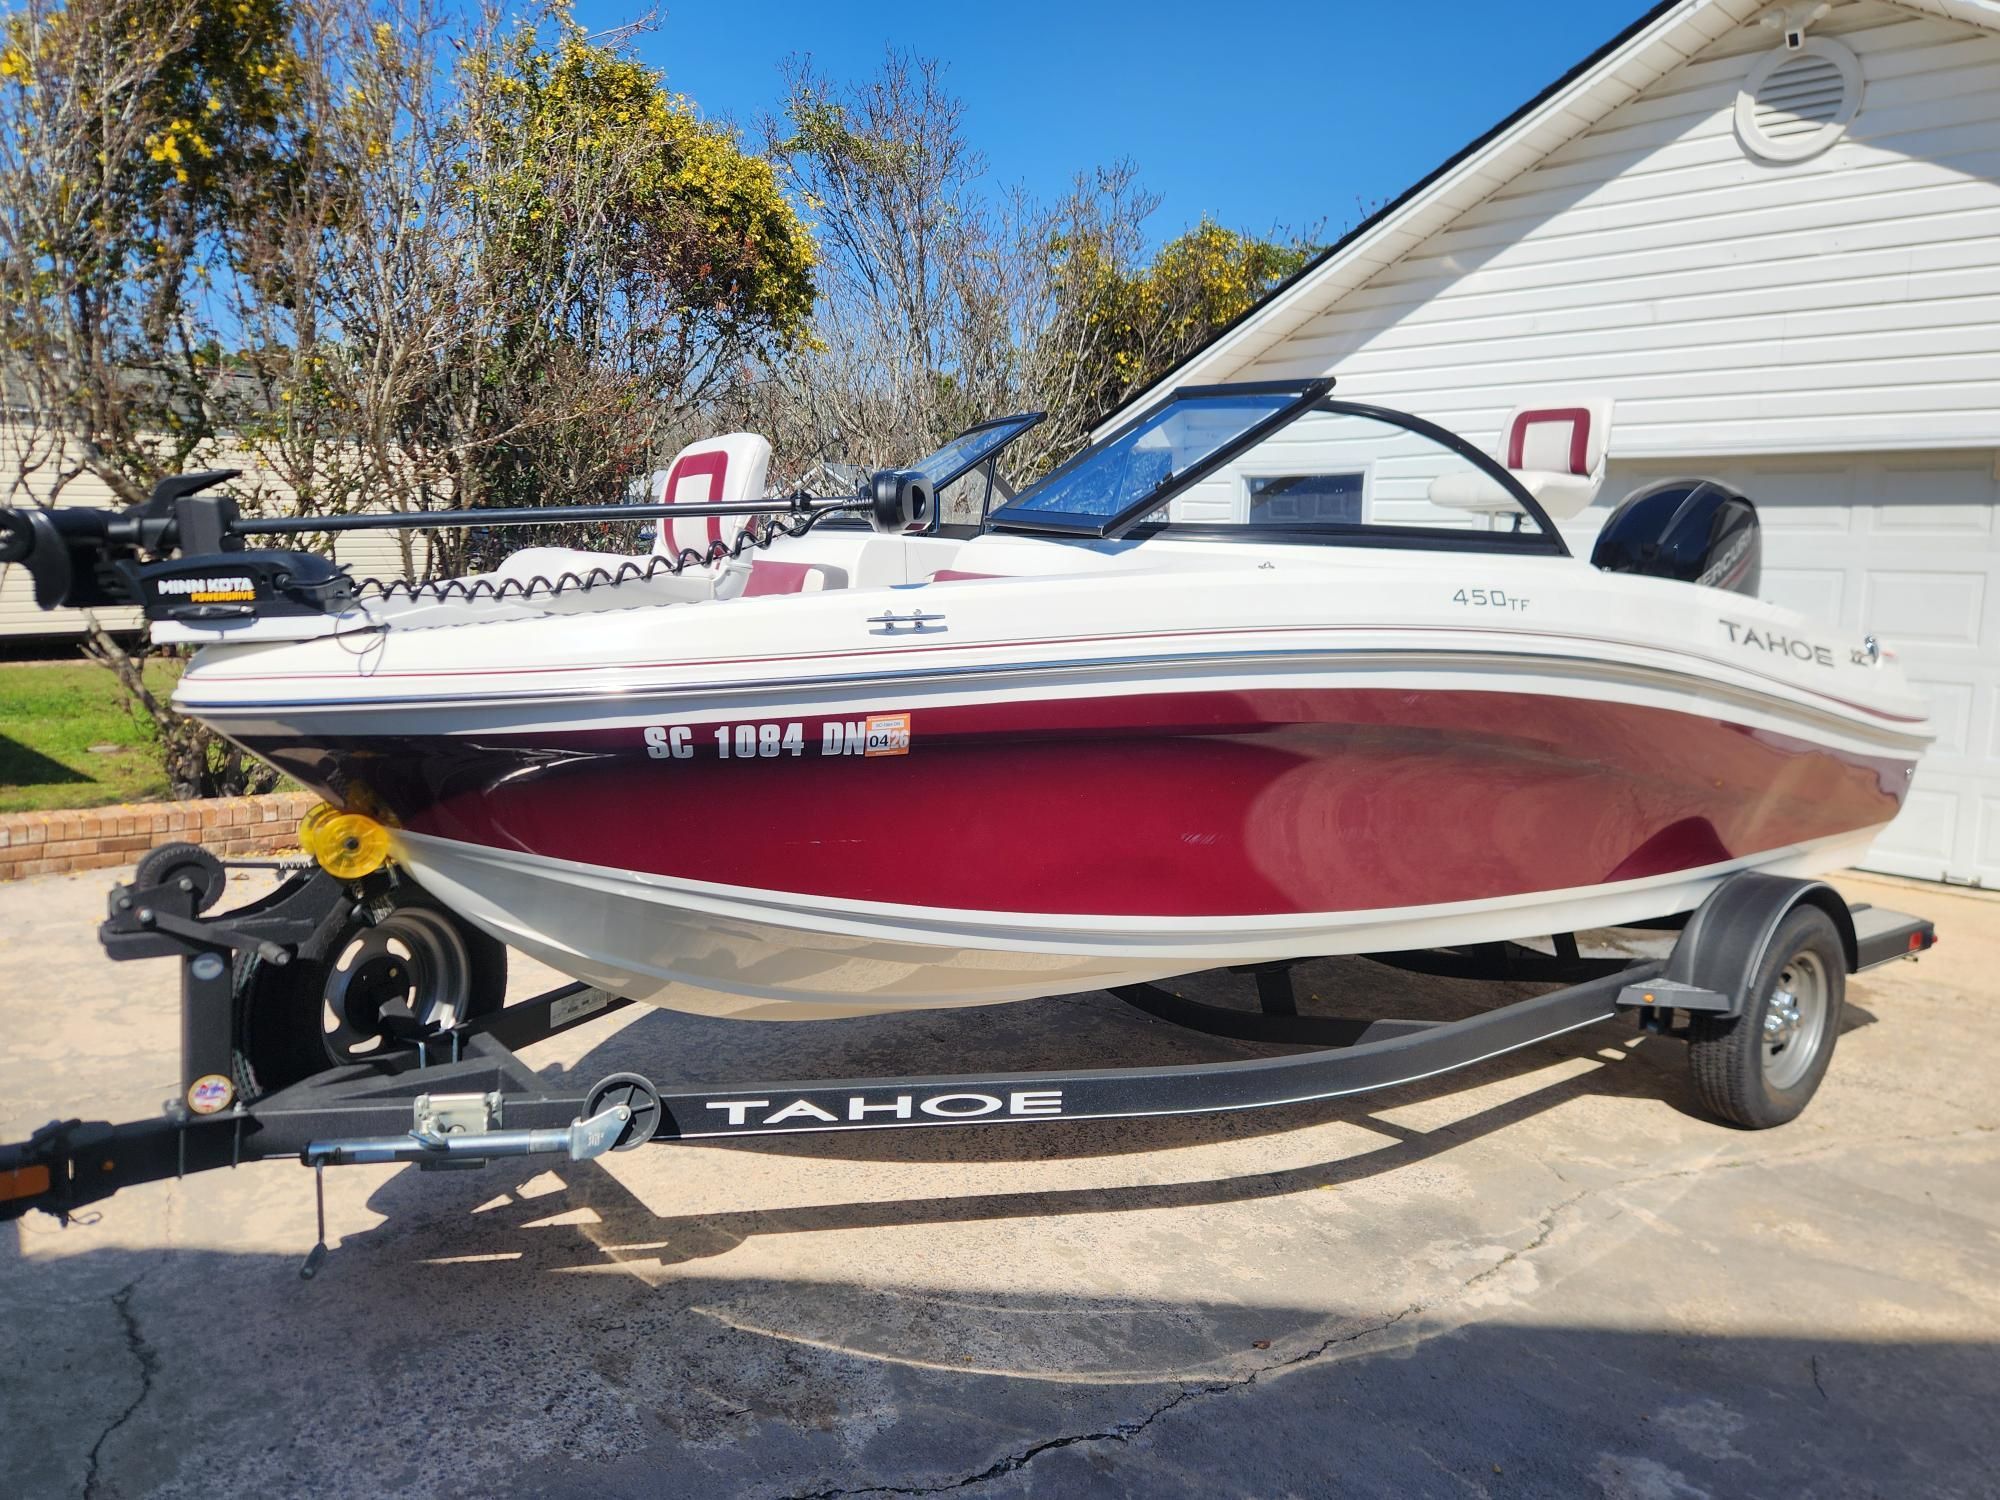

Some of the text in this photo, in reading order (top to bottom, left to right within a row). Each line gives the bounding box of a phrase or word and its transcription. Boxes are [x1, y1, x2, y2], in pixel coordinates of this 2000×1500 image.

[1695, 521, 1755, 588] ERCURY
[157, 577, 255, 595] MINN KOTA
[1718, 618, 1835, 668] TAHOE
[643, 721, 866, 759] SC 1084 DN
[705, 1090, 1063, 1126] TAHOE
